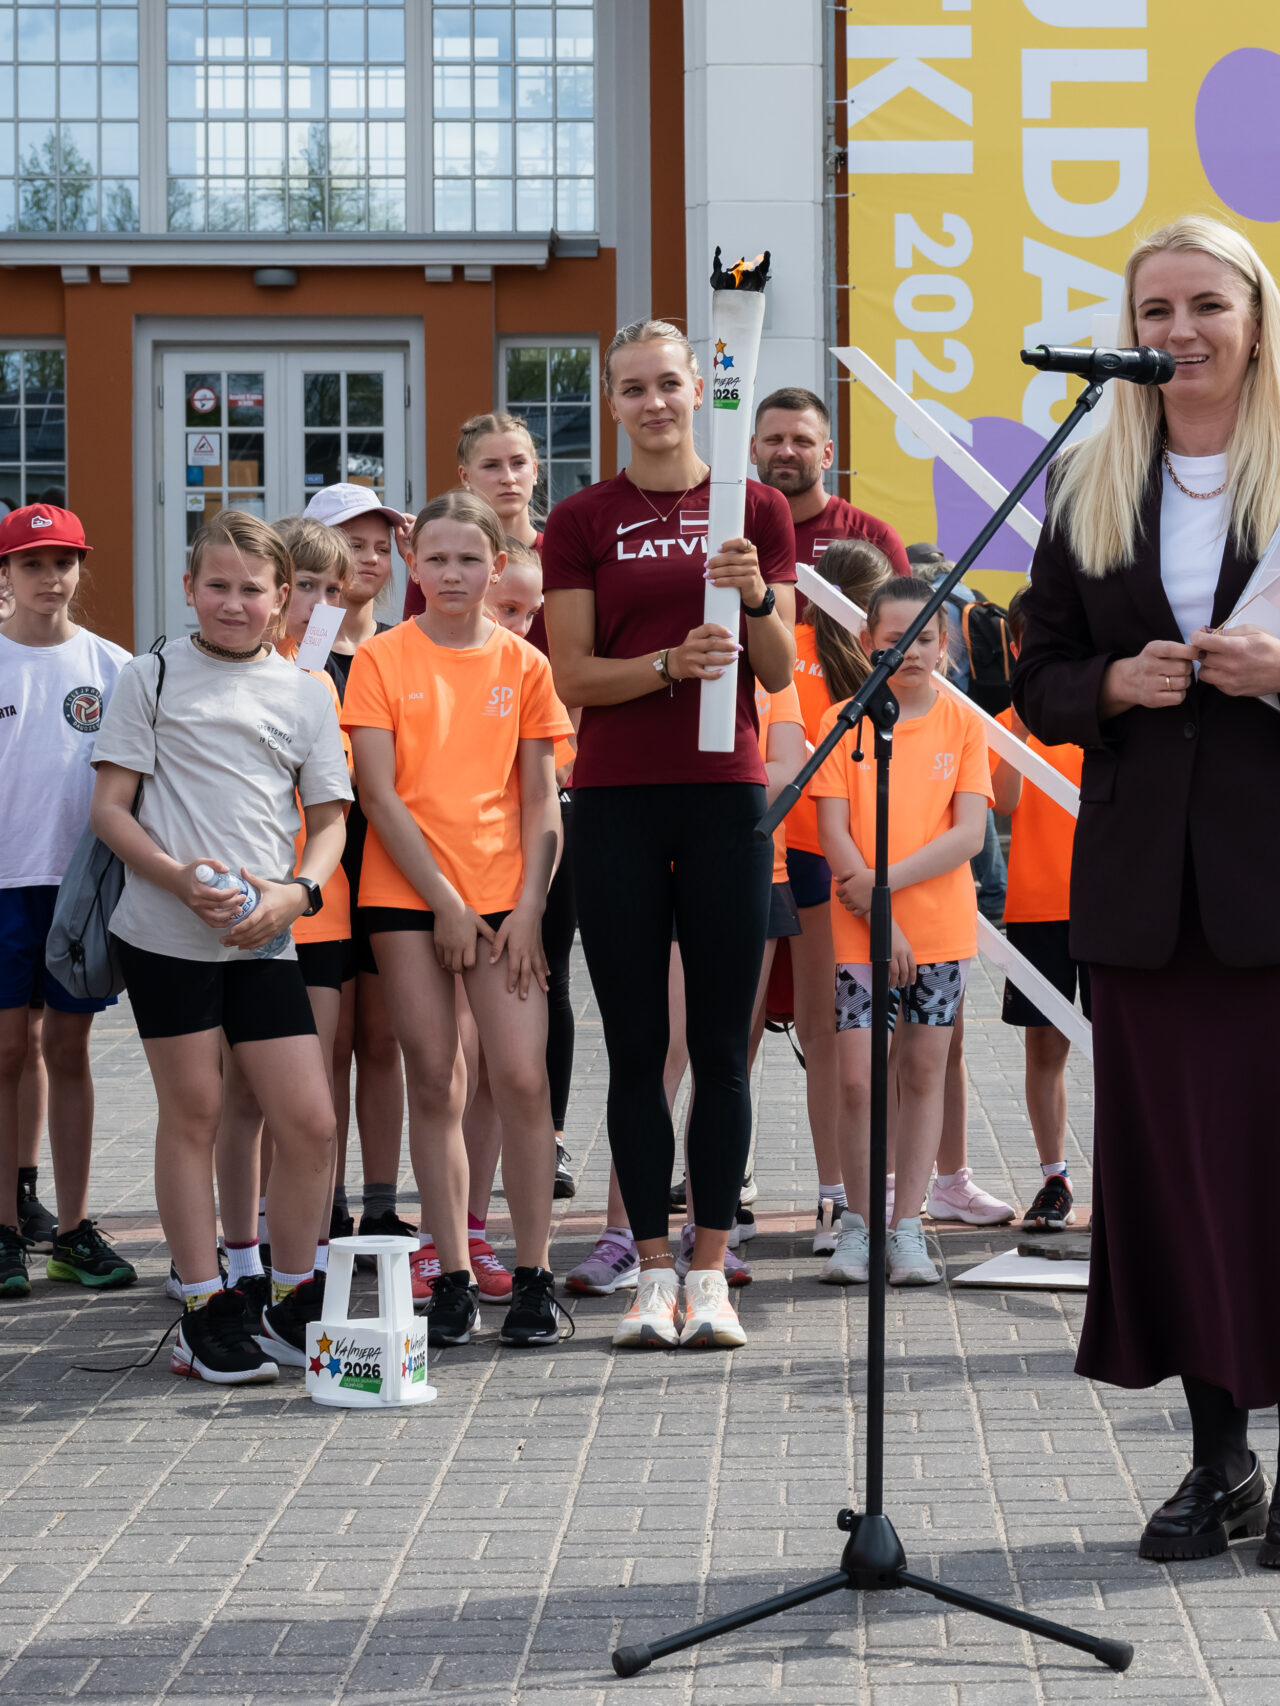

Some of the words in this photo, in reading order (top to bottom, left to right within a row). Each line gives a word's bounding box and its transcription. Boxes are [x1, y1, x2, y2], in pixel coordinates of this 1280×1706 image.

[847, 0, 974, 175] KI
[1021, 0, 1149, 452] LDA
[617, 536, 709, 560] LATVI
[343, 1362, 381, 1378] 2026
